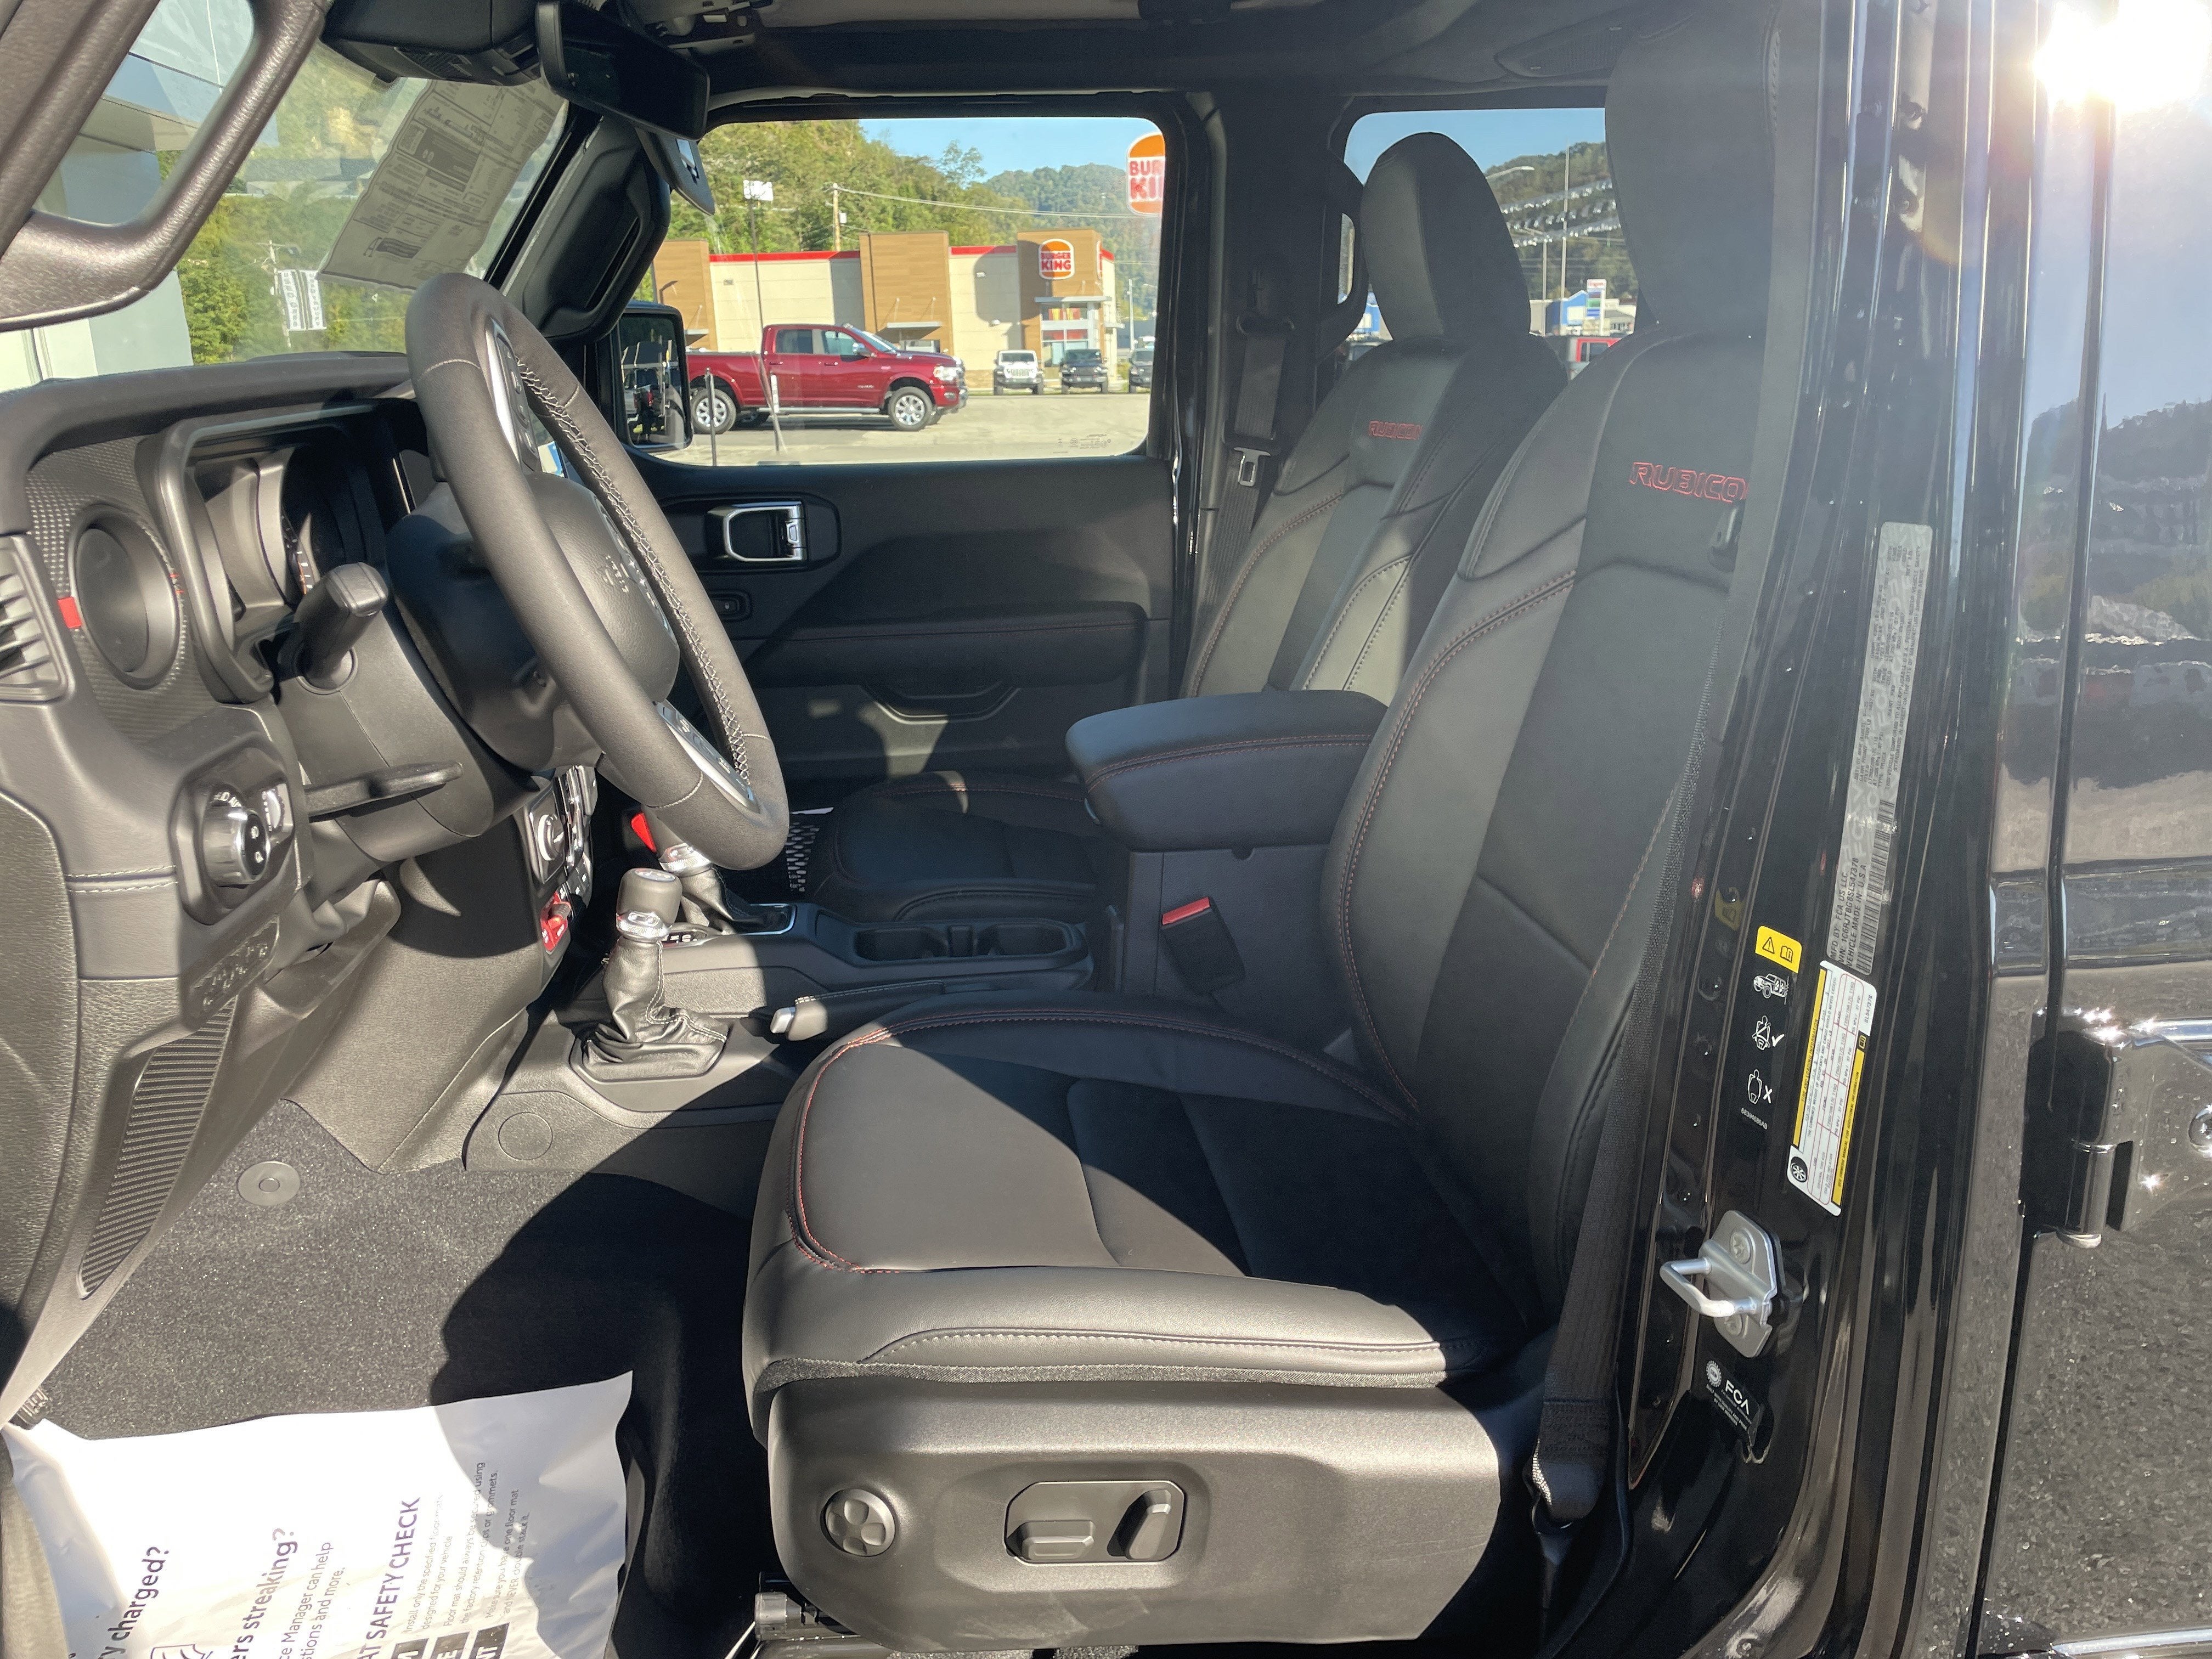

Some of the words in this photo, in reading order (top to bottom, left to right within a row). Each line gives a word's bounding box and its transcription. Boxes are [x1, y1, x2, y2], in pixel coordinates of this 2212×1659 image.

[1131, 177, 1164, 199] KI
[1041, 260, 1071, 270] KING
[1629, 461, 1749, 503] RUBICO
[1838, 889, 1845, 901] US
[1851, 904, 1861, 930] MADE
[1846, 932, 1857, 968] VEHICLE
[1809, 1018, 1818, 1054] INFORMATION
[1725, 1380, 1750, 1415] FCA
[474, 1462, 485, 1487] using
[471, 1489, 481, 1522] secured
[510, 1488, 518, 1505] mat
[484, 1519, 491, 1527] or
[505, 1508, 516, 1526] floor
[466, 1525, 476, 1535] be
[478, 1528, 491, 1547] clips
[504, 1528, 512, 1544] one
[311, 1542, 334, 1570] help
[422, 1542, 436, 1577] specified
[442, 1536, 452, 1564] vehicle
[462, 1537, 473, 1564] always
[499, 1546, 510, 1566] have
[513, 1544, 523, 1575] double
[365, 1572, 404, 1640] SAFETY
[389, 1497, 420, 1568] CHECK
[436, 1565, 447, 1582] your
[472, 1550, 485, 1583] retention
[497, 1568, 506, 1583] you
[242, 1528, 298, 1629] streaking?
[306, 1572, 323, 1590] can
[416, 1578, 427, 1590] the
[431, 1583, 442, 1594] for
[455, 1566, 467, 1590] should
[107, 1546, 169, 1641] charged?
[413, 1593, 425, 1607] only
[452, 1592, 461, 1606] mat
[463, 1585, 479, 1611] factory
[493, 1584, 503, 1598] sure
[506, 1578, 519, 1601] NEVER
[280, 1593, 313, 1643] Manager
[317, 1599, 332, 1621] and
[421, 1595, 438, 1629] designed
[443, 1609, 456, 1626] Floor
[460, 1612, 471, 1624] the
[485, 1600, 499, 1618] Make
[504, 1601, 513, 1613] and
[403, 1609, 419, 1632] Install
